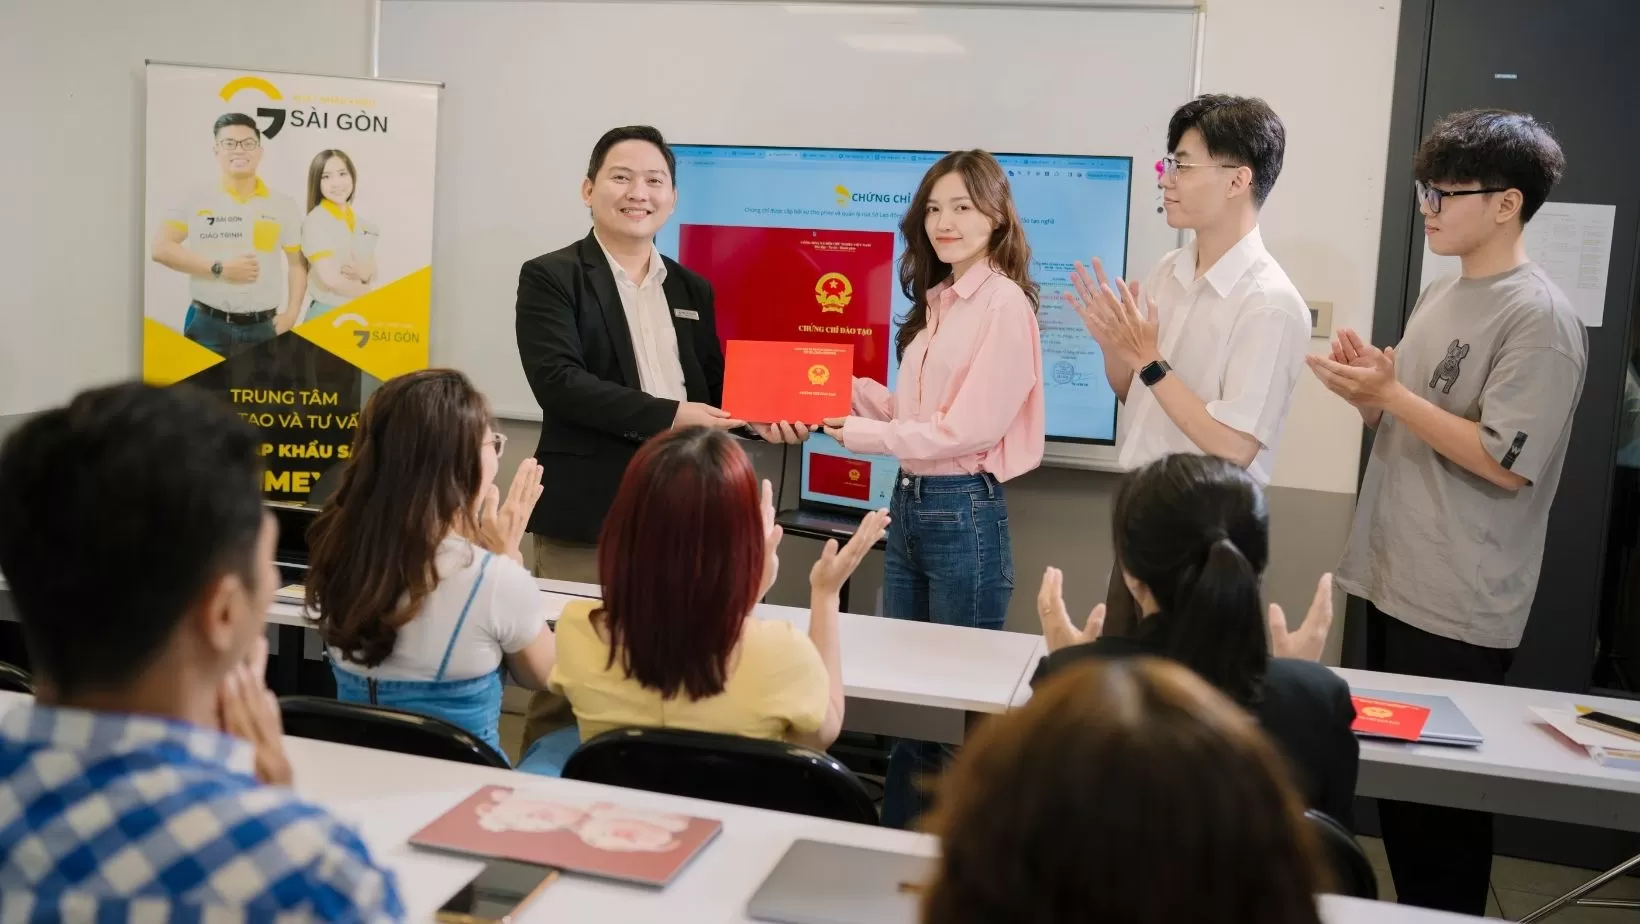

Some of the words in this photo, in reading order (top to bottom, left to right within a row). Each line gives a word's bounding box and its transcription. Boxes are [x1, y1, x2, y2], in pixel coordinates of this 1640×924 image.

[290, 106, 328, 129] SÀI
[336, 110, 388, 133] GÒN
[851, 191, 890, 203] CHỨNG
[371, 328, 391, 342] SÀI
[393, 330, 420, 344] GÒN
[798, 322, 825, 333] CHỨNG
[230, 389, 295, 405] TRUNG
[299, 388, 339, 406] TÂM
[278, 411, 303, 428] VÀ
[306, 412, 333, 429] TƯ
[335, 411, 361, 429] VẤ
[278, 439, 333, 458] KHẨU
